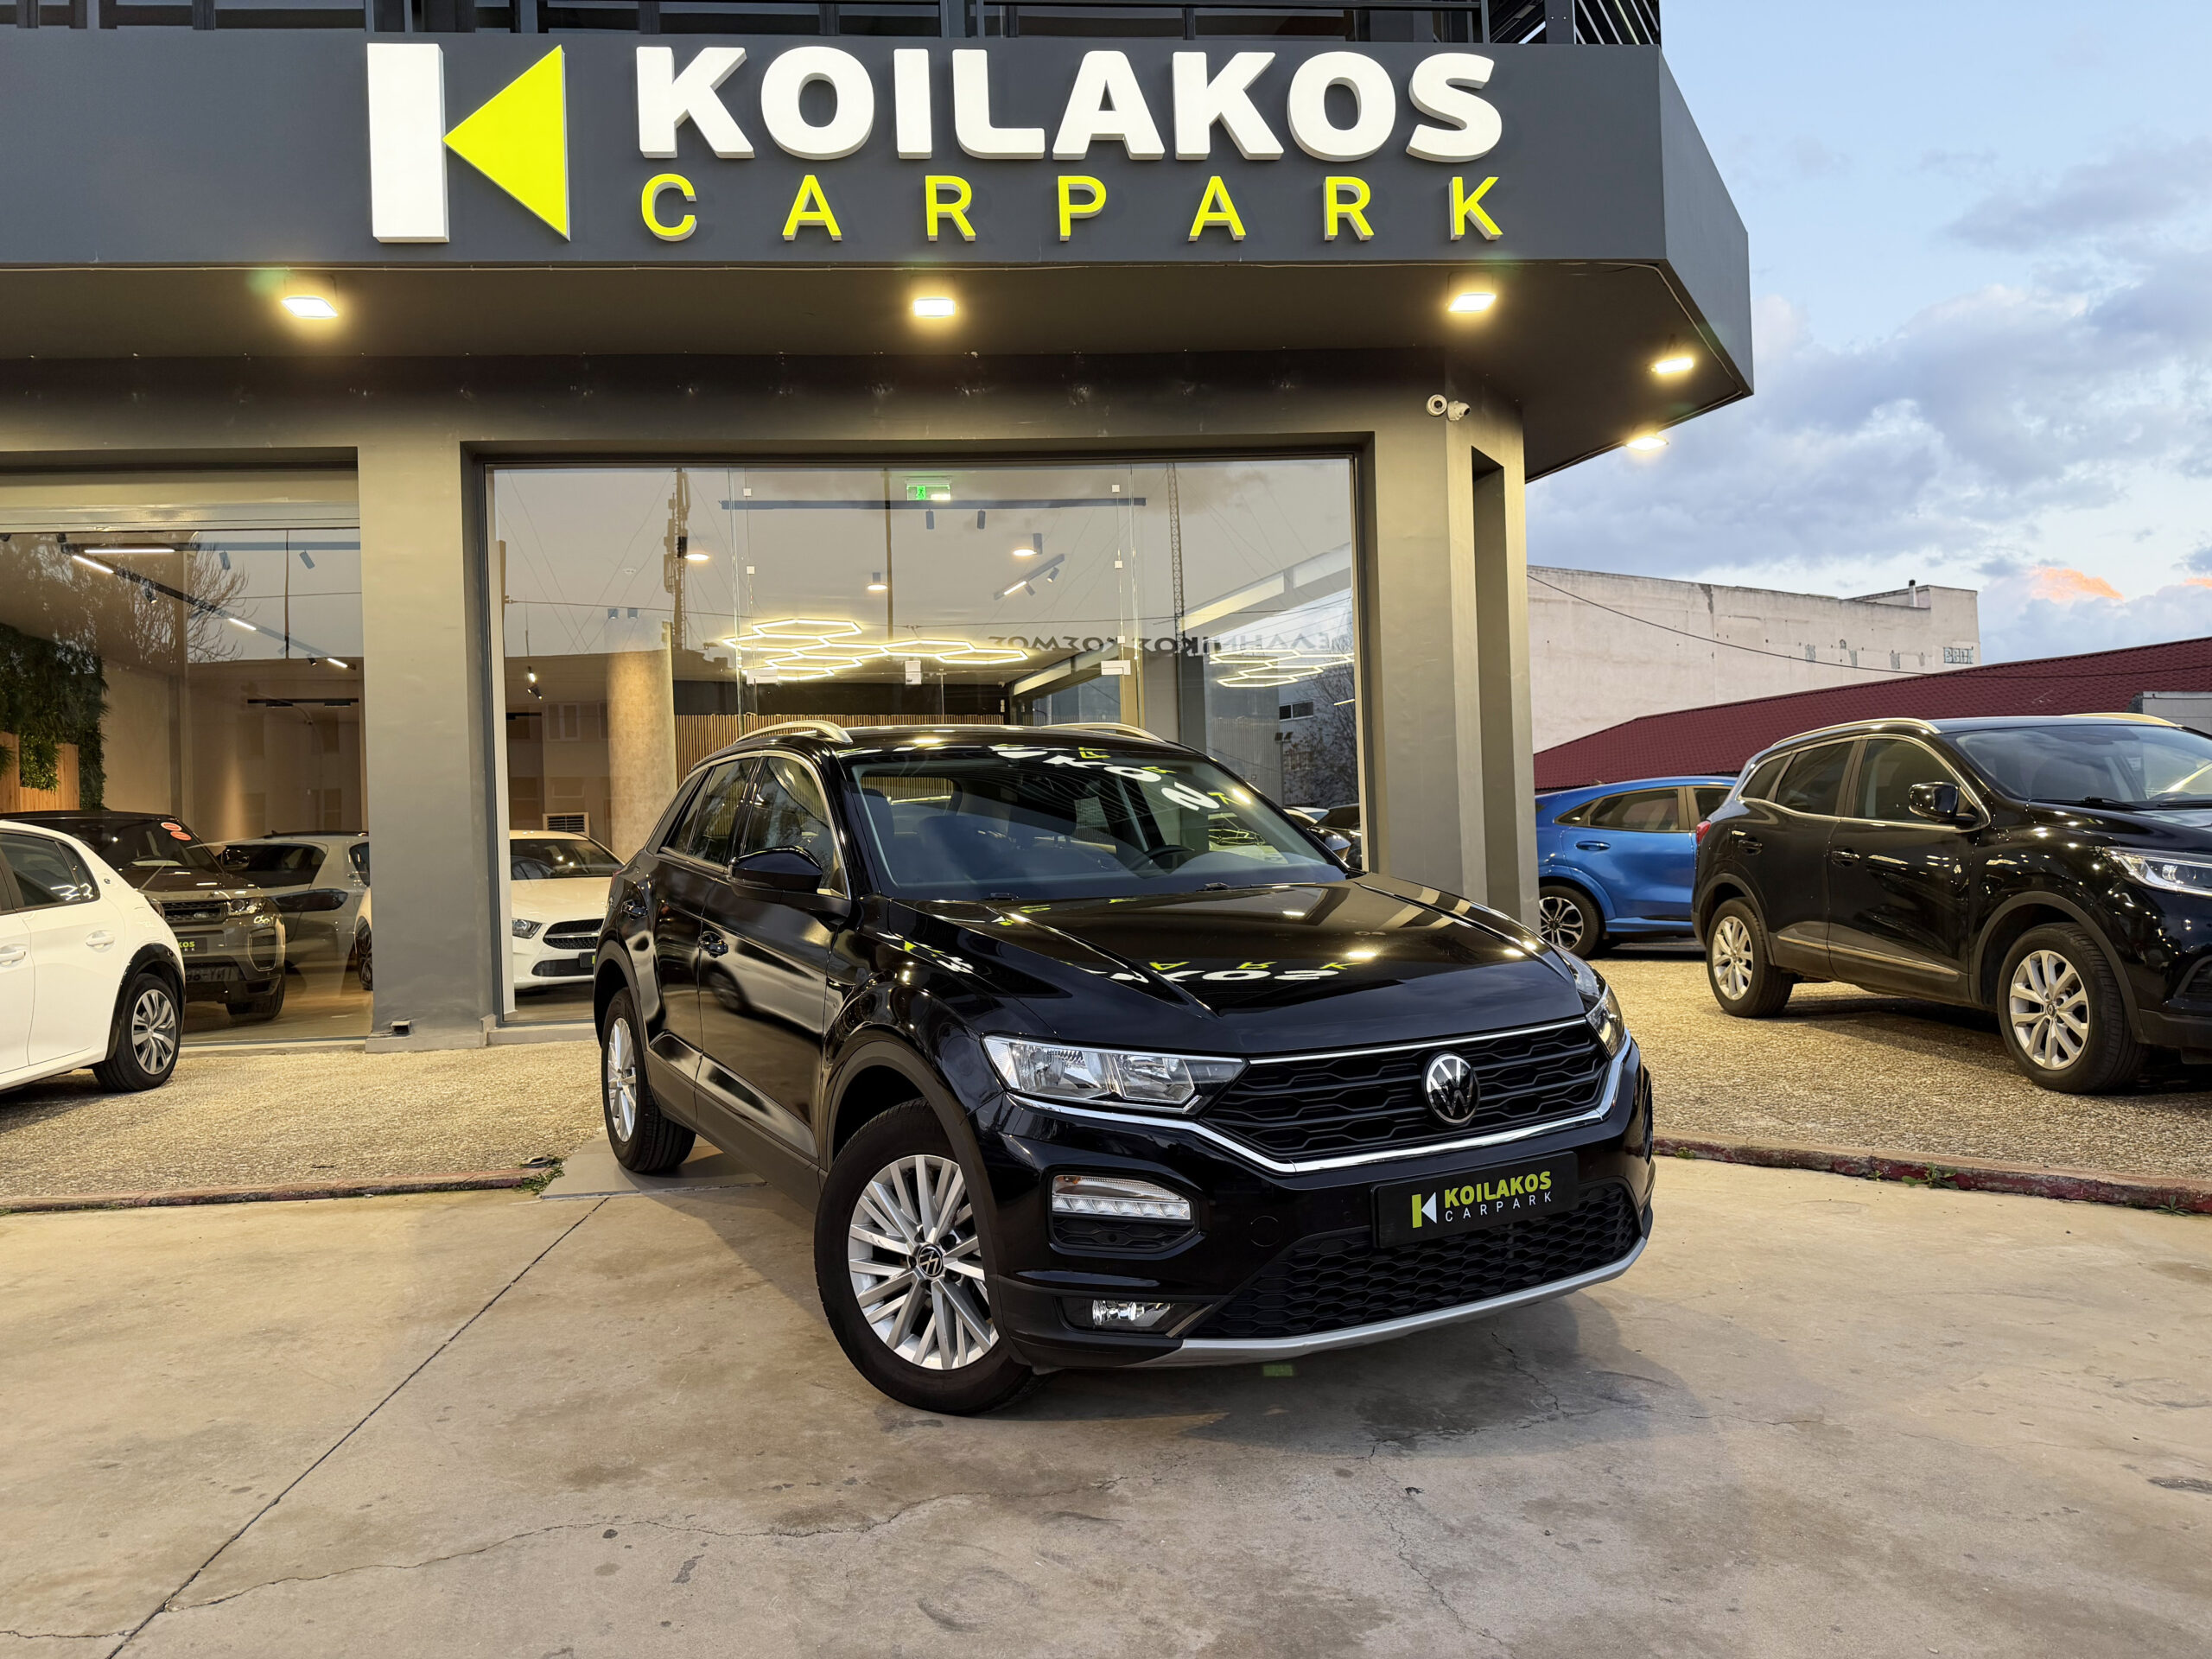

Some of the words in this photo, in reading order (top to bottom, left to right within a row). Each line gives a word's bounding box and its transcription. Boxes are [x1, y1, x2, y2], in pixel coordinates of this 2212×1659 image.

[636, 46, 1503, 162] KOILAKOS
[641, 173, 1503, 242] CARPARK
[1444, 1171, 1552, 1209] KOILAKOS
[1445, 1192, 1552, 1223] CARPARK
